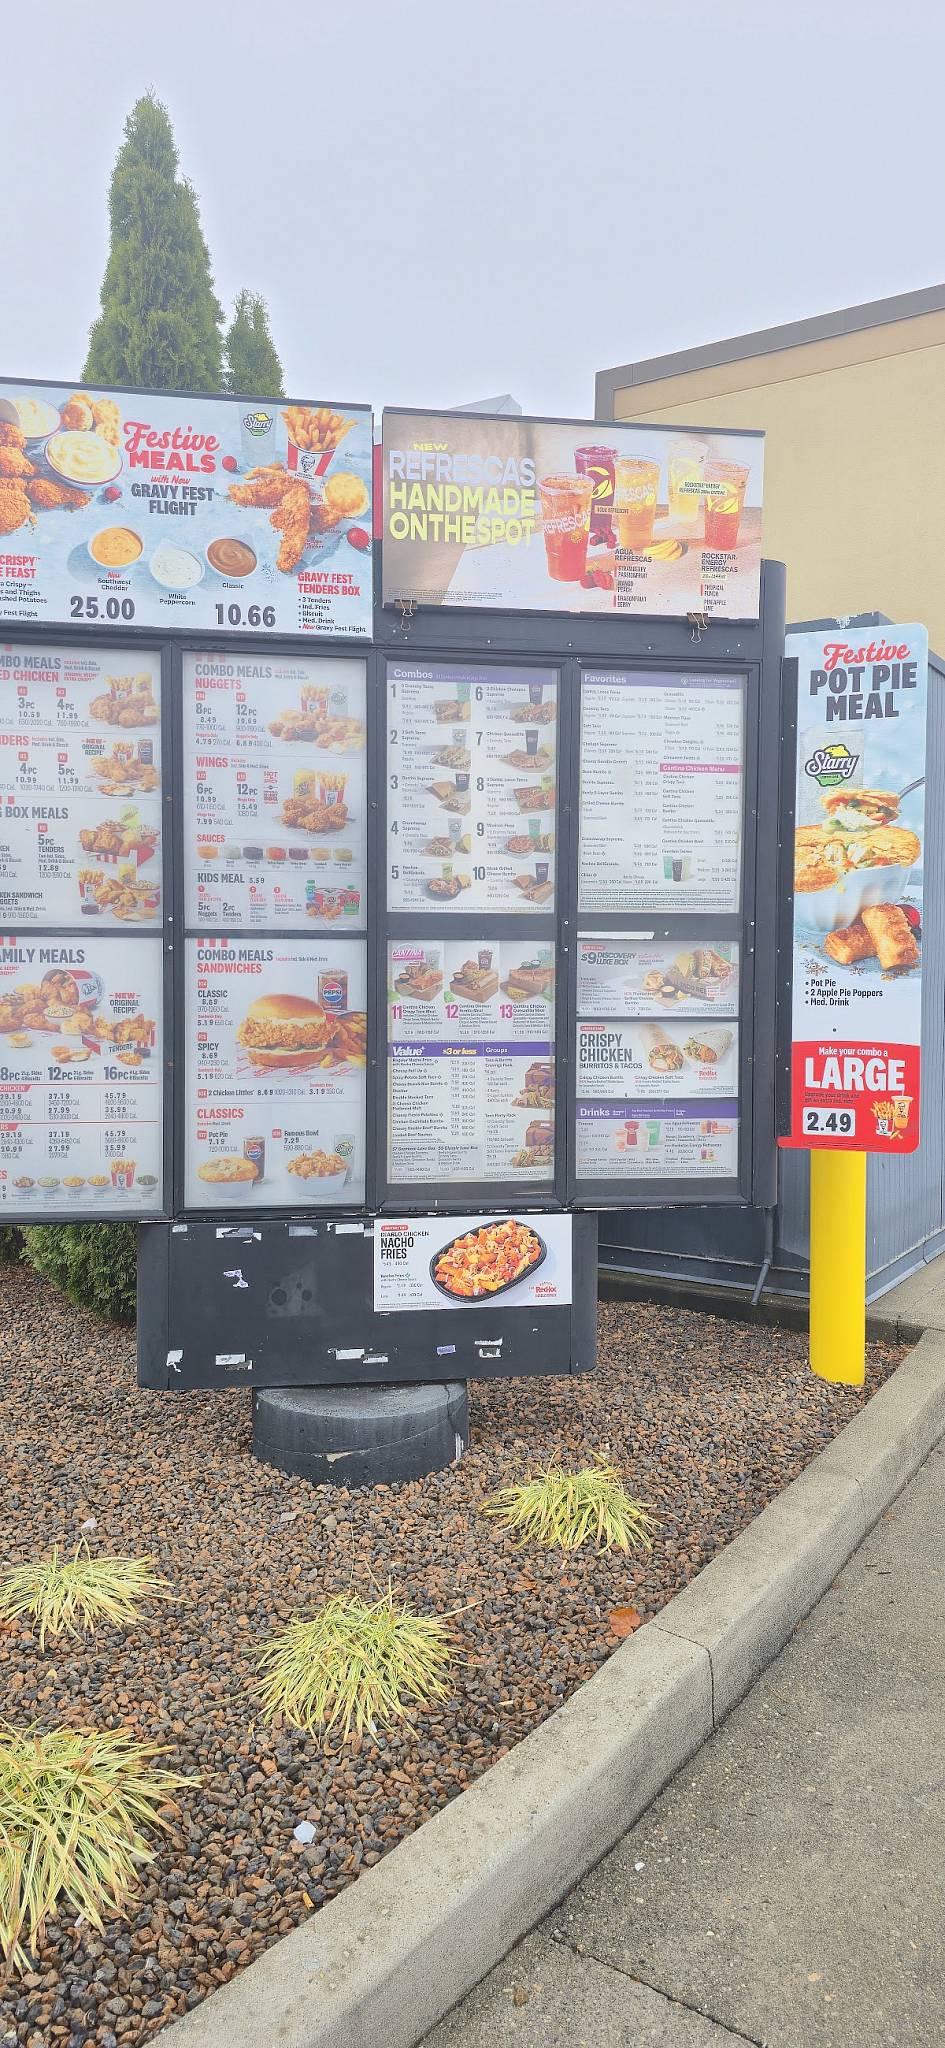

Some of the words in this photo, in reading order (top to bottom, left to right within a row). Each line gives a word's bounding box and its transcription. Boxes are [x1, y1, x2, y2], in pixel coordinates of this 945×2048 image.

[123, 421, 220, 452] Festive
[413, 443, 449, 451] NEW
[129, 451, 216, 474] MEALS
[389, 450, 536, 487] REFRESCAS
[151, 475, 169, 484] with
[131, 483, 179, 500] GRAVY
[182, 485, 215, 501] FEST
[390, 481, 536, 517] HANDMADE
[150, 501, 197, 515] FLIGHT
[615, 555, 652, 563] REFRESCAS
[701, 559, 727, 567] ENERGY
[6, 567, 36, 578] FEAST
[701, 565, 738, 573] REFRESCAS
[298, 572, 330, 583] GRAVY
[332, 573, 353, 584] FEST
[298, 584, 340, 595] TENDERS
[341, 586, 360, 596] BOX
[70, 596, 135, 620] 25.00
[160, 598, 196, 606] Peppercorn
[215, 603, 276, 627] 10.66
[823, 639, 910, 671] Festive
[24, 656, 62, 670] MEALS
[13, 670, 60, 682] CHICKEN
[195, 664, 234, 677] COMBO
[237, 665, 272, 679] MEALS
[394, 669, 433, 679] Combos
[195, 678, 242, 690] NUGGETS
[584, 673, 627, 684] Favorites
[810, 666, 865, 696] POT
[872, 661, 918, 691] PIE
[390, 684, 397, 698] 1
[475, 686, 483, 701] 6
[826, 691, 899, 722] MEAL
[390, 730, 398, 744] 2
[476, 731, 484, 745] 7
[196, 757, 229, 768] WINGS
[805, 750, 860, 779] Starry
[390, 775, 398, 789] 3
[476, 777, 484, 791] 8
[5, 806, 28, 818] BOX
[32, 807, 69, 819] MEALS
[391, 821, 399, 835] 4
[477, 822, 484, 836] 9
[196, 834, 226, 843] SAUCES
[391, 865, 399, 879] 5
[473, 866, 486, 880] 10
[197, 873, 220, 884] KIDS
[221, 873, 246, 885] MEAL
[39, 949, 86, 964] MEALS
[197, 949, 236, 962] COMBO
[239, 949, 274, 962] MEALS
[613, 958, 629, 966] BOX
[196, 963, 263, 974] SANDWICHES
[811, 979, 823, 987] Pot
[825, 979, 836, 987] Pie
[197, 990, 229, 998] CLASSIC
[817, 989, 838, 997] Apple
[853, 990, 883, 998] Poppers
[109, 999, 140, 1007] ORIGINAL
[391, 1005, 402, 1019] 11
[445, 1004, 458, 1019] 12
[499, 1004, 513, 1019] 13
[580, 1033, 622, 1048] CRISPY
[108, 1043, 133, 1053] TENDERS
[197, 1043, 219, 1052] SPICY
[485, 1047, 508, 1055] Groups
[819, 1047, 838, 1056] Make
[839, 1049, 856, 1057] your
[857, 1048, 882, 1056] combo
[580, 1048, 632, 1062] CHICKEN
[805, 1057, 905, 1091] LARGE
[197, 1108, 244, 1119] CLASSICS
[580, 1107, 610, 1117] Drinks
[807, 1111, 851, 1132] 2.49
[380, 1236, 414, 1248] NACHO
[380, 1248, 407, 1260] FRIES
